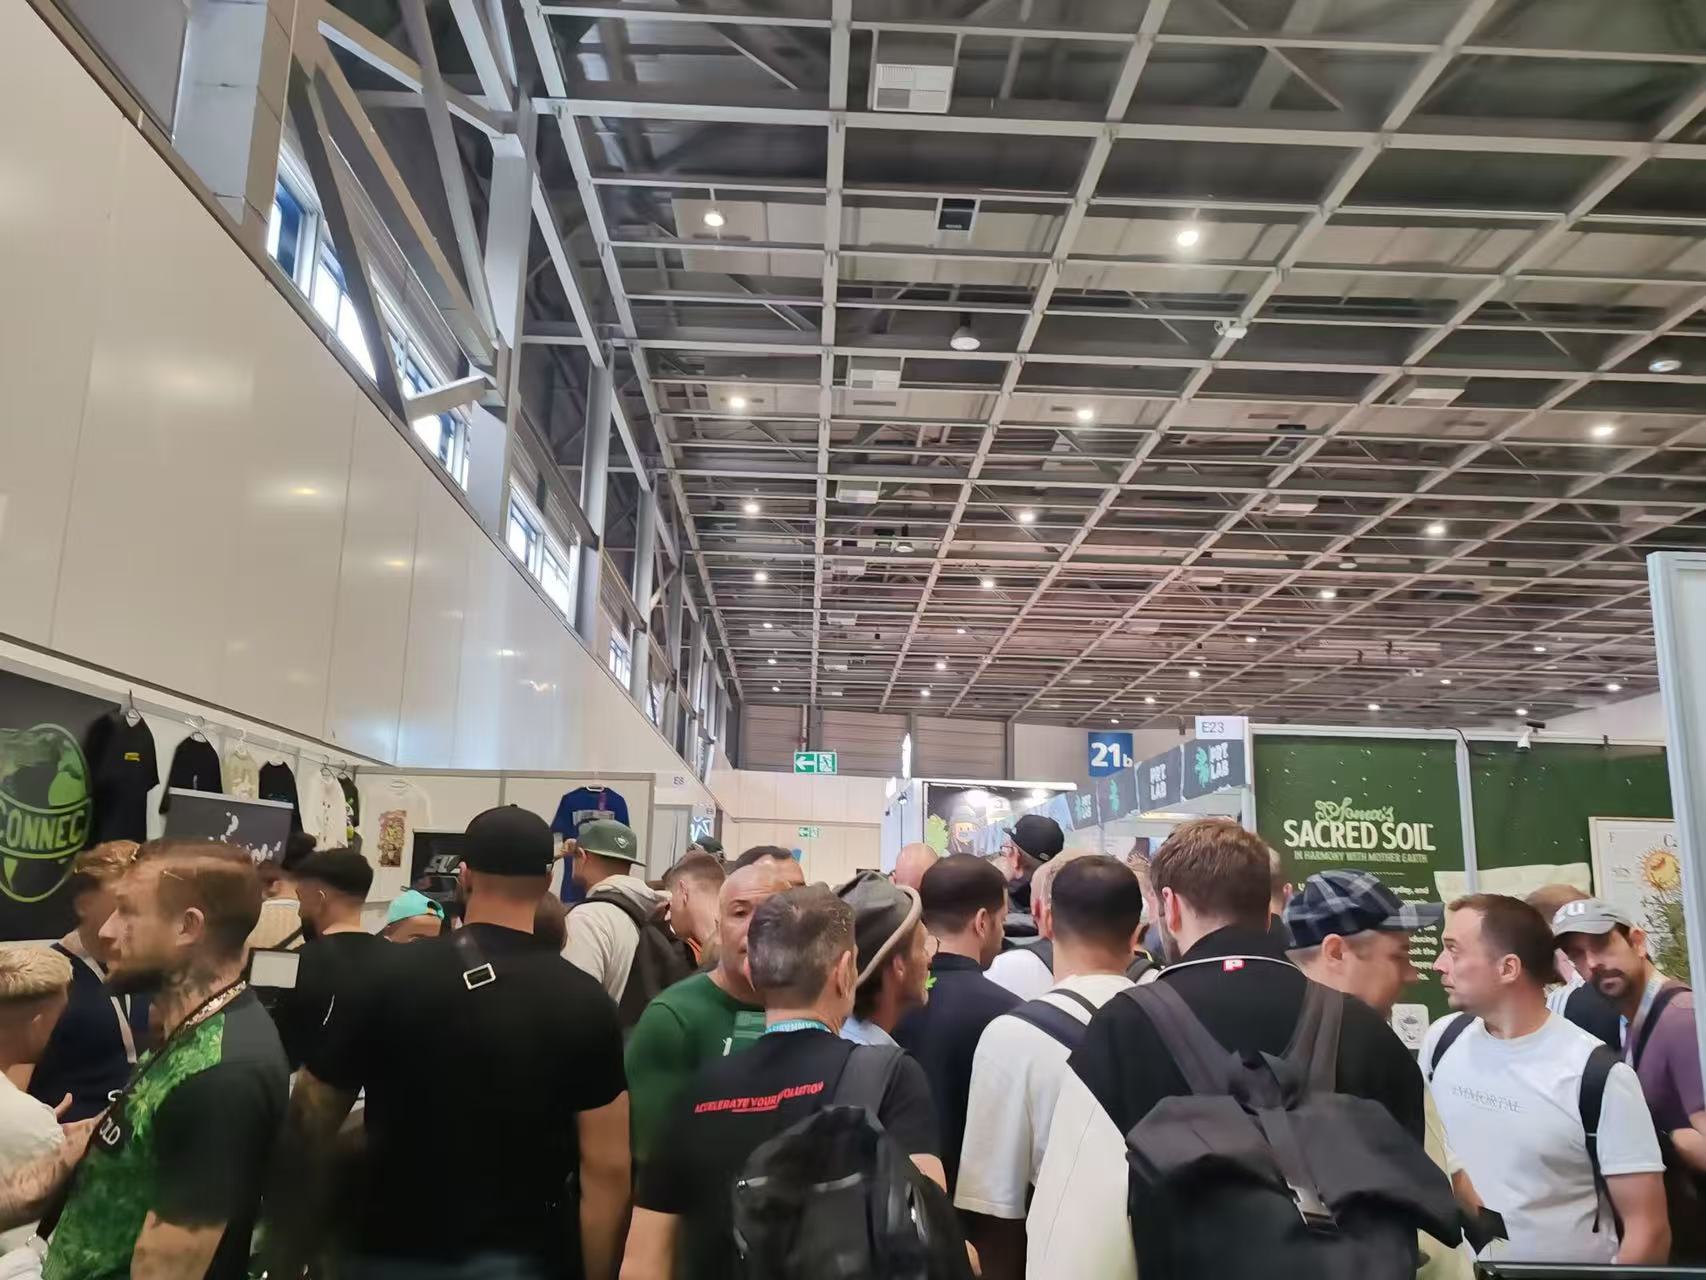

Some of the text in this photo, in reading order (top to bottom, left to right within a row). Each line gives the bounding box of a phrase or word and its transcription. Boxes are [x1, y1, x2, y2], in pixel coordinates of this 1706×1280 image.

[1201, 721, 1225, 734] E23
[1090, 741, 1134, 769] 21b
[1283, 819, 1379, 849] SACRED
[1294, 850, 1429, 864] IN HARMONY WITH MOTHER EARTH
